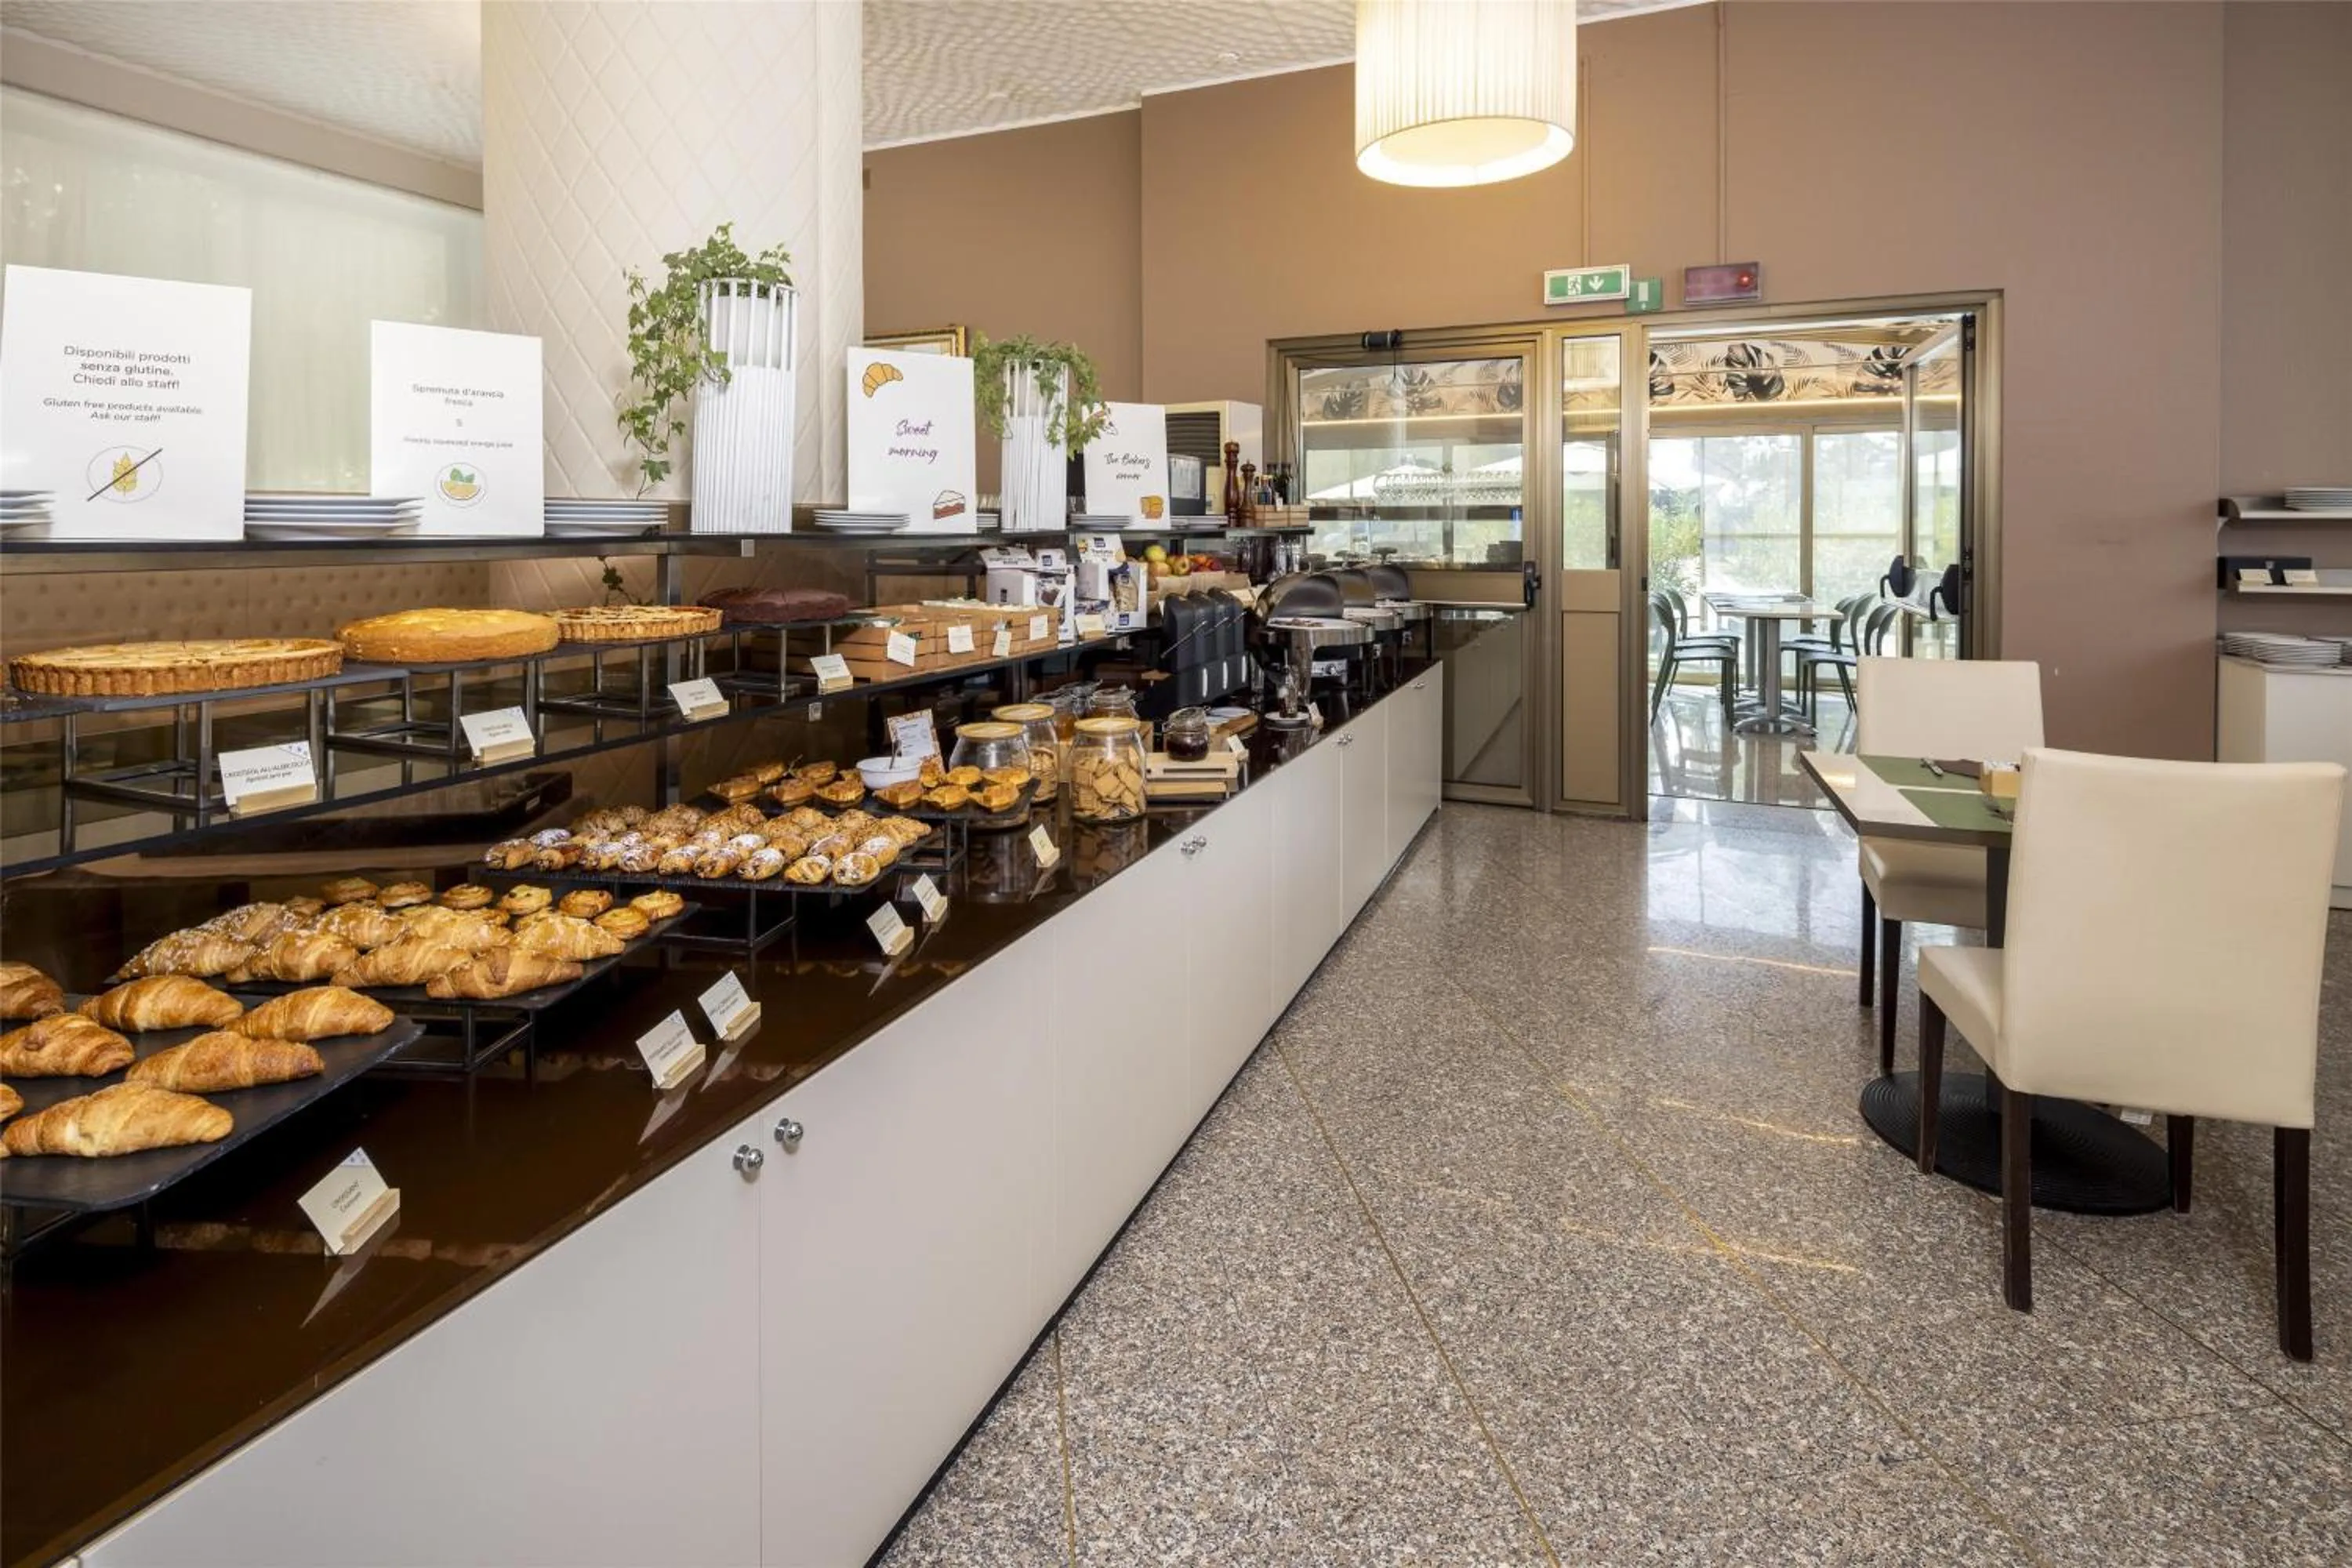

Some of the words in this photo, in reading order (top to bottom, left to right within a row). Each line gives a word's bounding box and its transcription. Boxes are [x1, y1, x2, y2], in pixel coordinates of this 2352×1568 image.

[64, 346, 136, 360] Disponibili
[139, 352, 191, 364] prodotti
[80, 362, 120, 372] senza
[125, 365, 174, 376] glutine.
[73, 373, 116, 386] Chiedi
[120, 377, 143, 387] allo
[147, 379, 180, 390] staff!
[43, 397, 81, 408] Gluten
[84, 401, 104, 409] free
[107, 402, 153, 412] products
[896, 419, 935, 436] Sweet
[887, 447, 938, 465] morning
